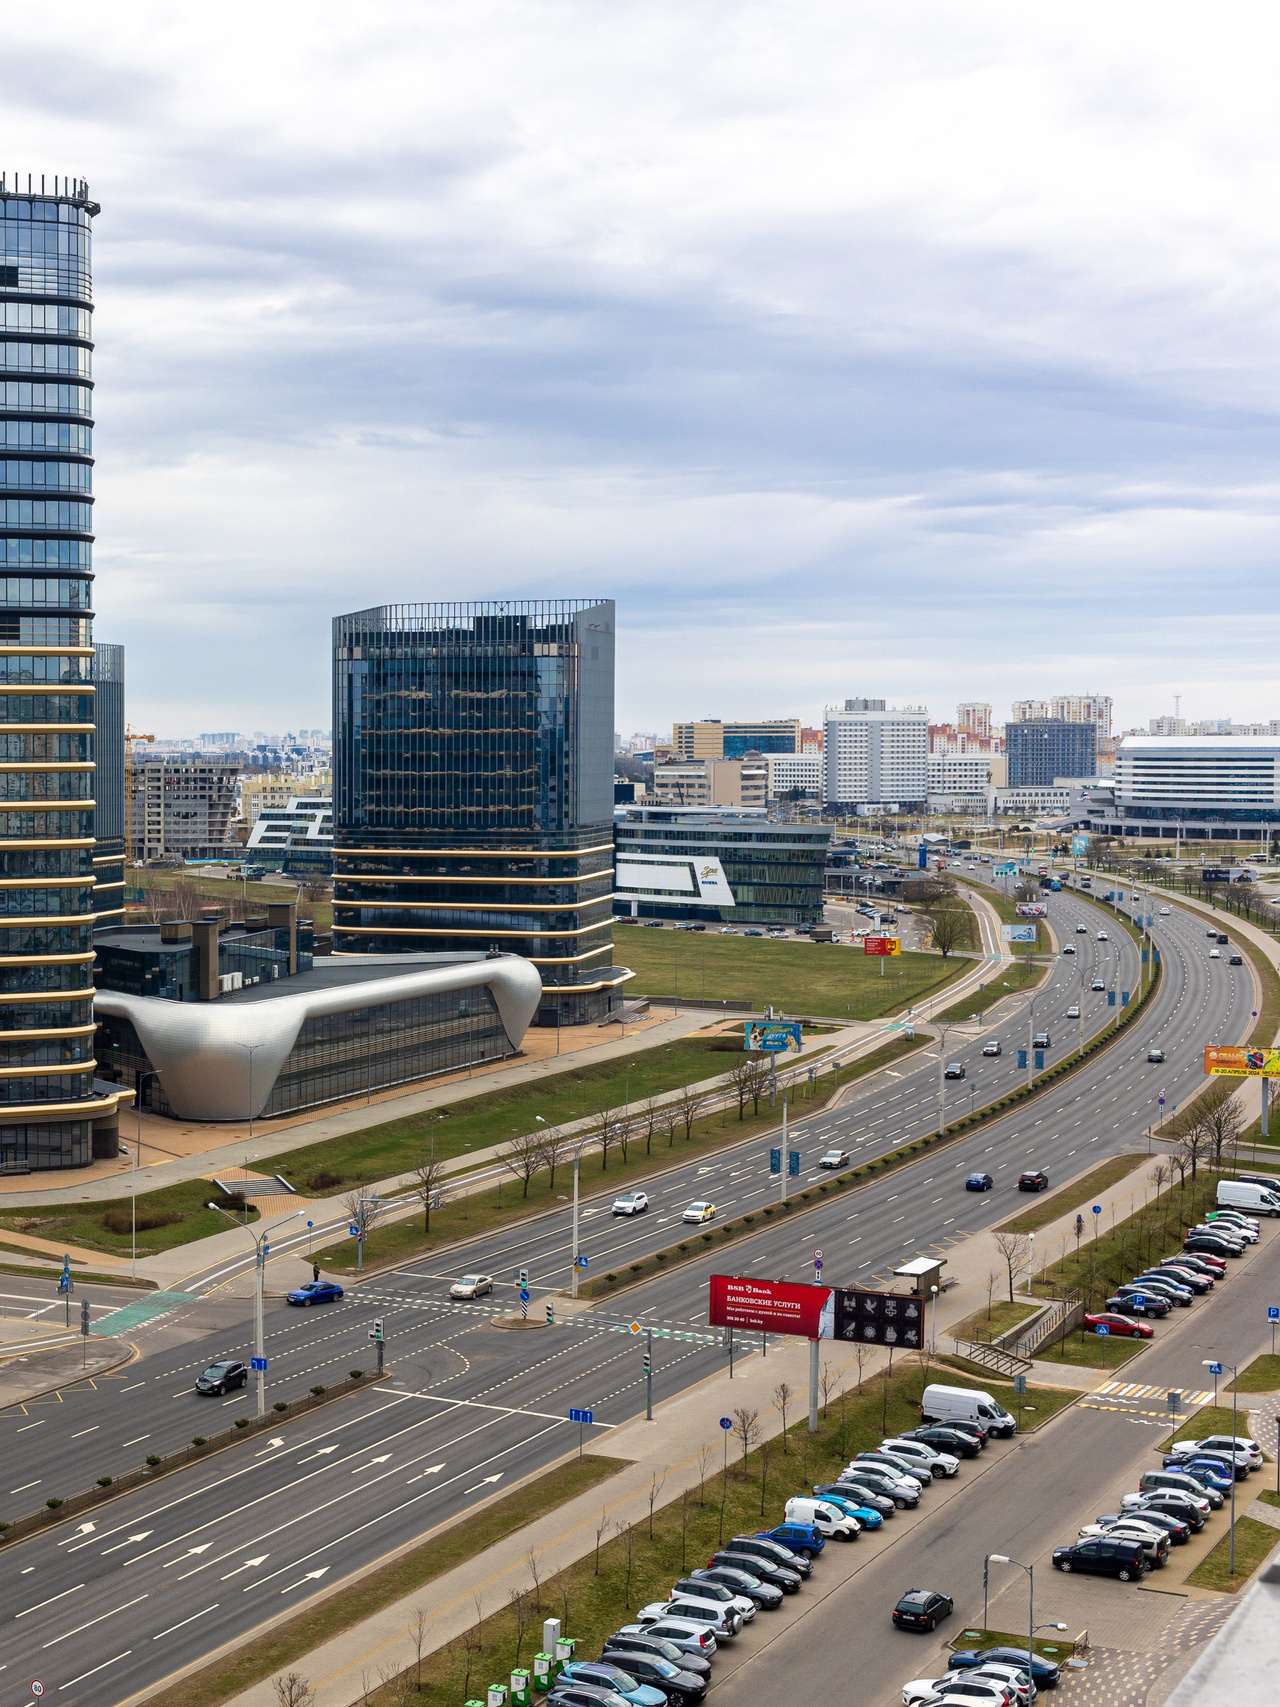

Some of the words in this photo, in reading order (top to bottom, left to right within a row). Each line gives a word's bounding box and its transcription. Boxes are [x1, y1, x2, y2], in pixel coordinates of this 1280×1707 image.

[701, 866, 718, 879] Spa
[727, 1296, 772, 1306] БАНКОВСКИЕ
[773, 1301, 800, 1309] УСЛУГИ
[34, 1684, 41, 1692] 80
